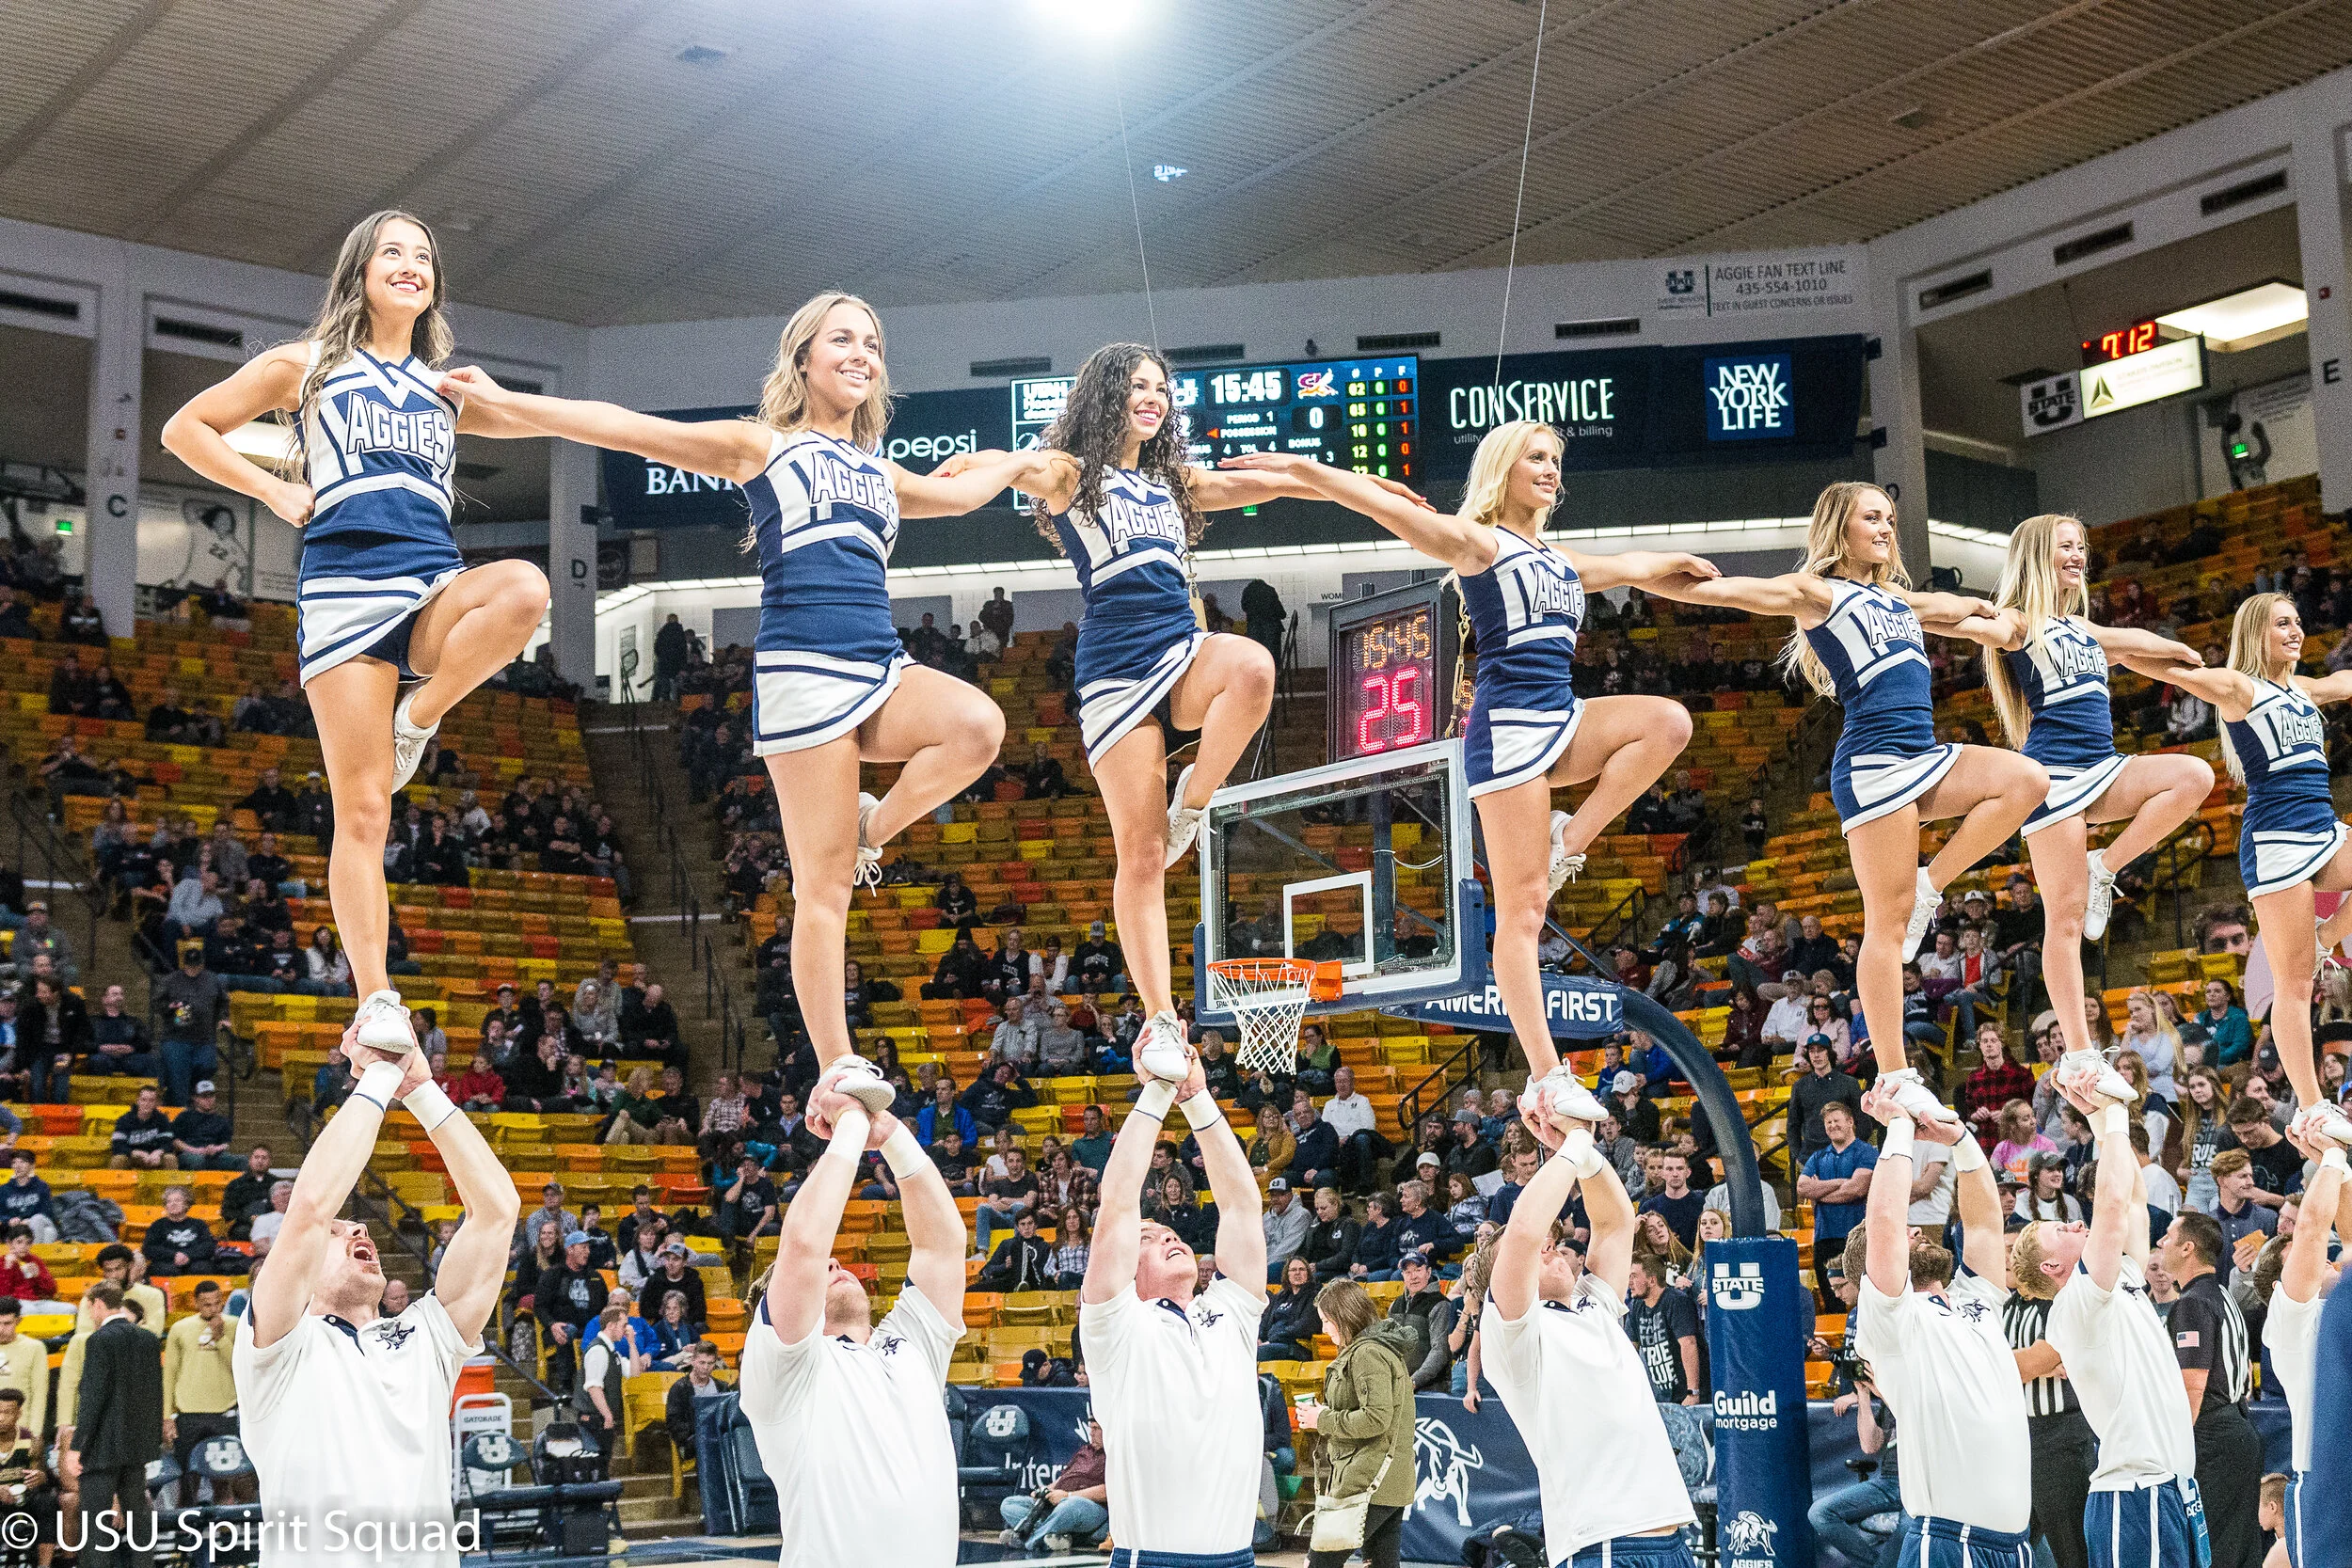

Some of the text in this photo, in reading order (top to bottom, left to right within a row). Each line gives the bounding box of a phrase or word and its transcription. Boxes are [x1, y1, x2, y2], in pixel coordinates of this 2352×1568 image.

[1715, 261, 1847, 280] AGGIE FAN TEXT LINE
[1736, 277, 1827, 294] 435-554-1010
[1398, 365, 1406, 376] F
[1719, 363, 1780, 389] NEW
[2323, 359, 2341, 385] E
[1211, 372, 1281, 404] 15:45
[1375, 381, 1385, 395] 0
[1398, 380, 1408, 394] 0
[1708, 382, 1788, 410] YORK
[1375, 402, 1386, 416] 0
[1400, 401, 1408, 414] 1
[1450, 378, 1615, 429] CONSERVICE
[1266, 410, 1274, 421] 1
[1309, 406, 1324, 429] 0
[1722, 404, 1781, 430] LIFE
[345, 390, 451, 470] AGGIES
[1376, 422, 1387, 436] 0
[1401, 421, 1408, 435] 1
[1579, 425, 1613, 437] billing
[887, 428, 977, 462] pepsi
[1223, 443, 1232, 455] 4
[1267, 440, 1277, 451] 4
[1352, 442, 1410, 459] 12 0 0
[1326, 451, 1334, 463] 3
[1378, 465, 1388, 478] 0
[1402, 464, 1410, 476] 1
[107, 494, 128, 517] C
[571, 559, 588, 578] D
[1533, 563, 1585, 627] AGGIE
[1363, 614, 1431, 669] 15:45
[2061, 637, 2108, 679] AGGIE
[1359, 666, 1422, 753] 25
[1546, 990, 1618, 1022] FIRST
[2192, 1143, 2217, 1162] RUE
[1712, 1276, 1765, 1293] STATE
[1649, 1360, 1675, 1386] LUE
[1714, 1389, 1777, 1417] Guild
[464, 1415, 502, 1423] GATORADE
[1715, 1416, 1778, 1431] mortgage
